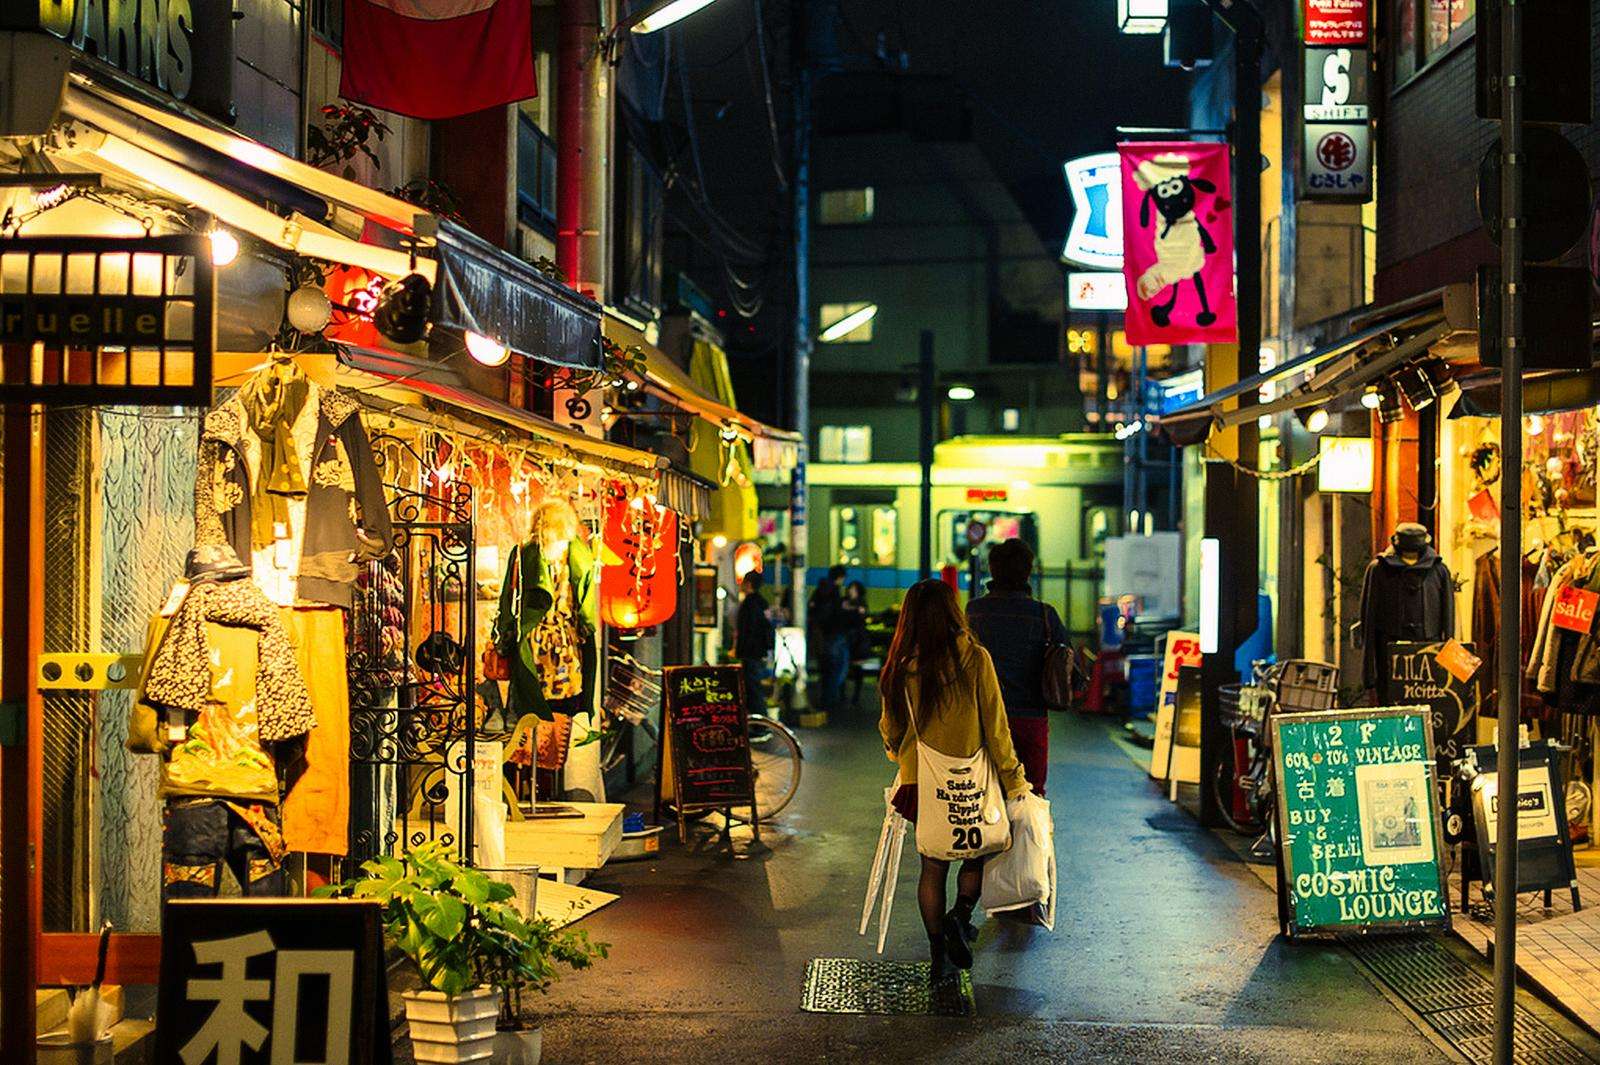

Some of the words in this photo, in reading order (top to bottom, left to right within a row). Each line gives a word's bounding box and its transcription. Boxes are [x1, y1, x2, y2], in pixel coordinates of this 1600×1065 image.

[1312, 107, 1363, 119] SHIFT
[1309, 173, 1363, 188] むさしや
[6, 307, 158, 334] ruelle
[1555, 598, 1593, 621] sale
[1355, 744, 1422, 763] VINTAGE
[1296, 777, 1346, 802] 古着
[1289, 808, 1331, 825] BUY
[952, 827, 983, 850] 20
[1312, 843, 1362, 859] SELL
[1296, 866, 1396, 899] COSMIC
[1338, 890, 1440, 921] LOUNGE
[178, 930, 355, 1065] 和
